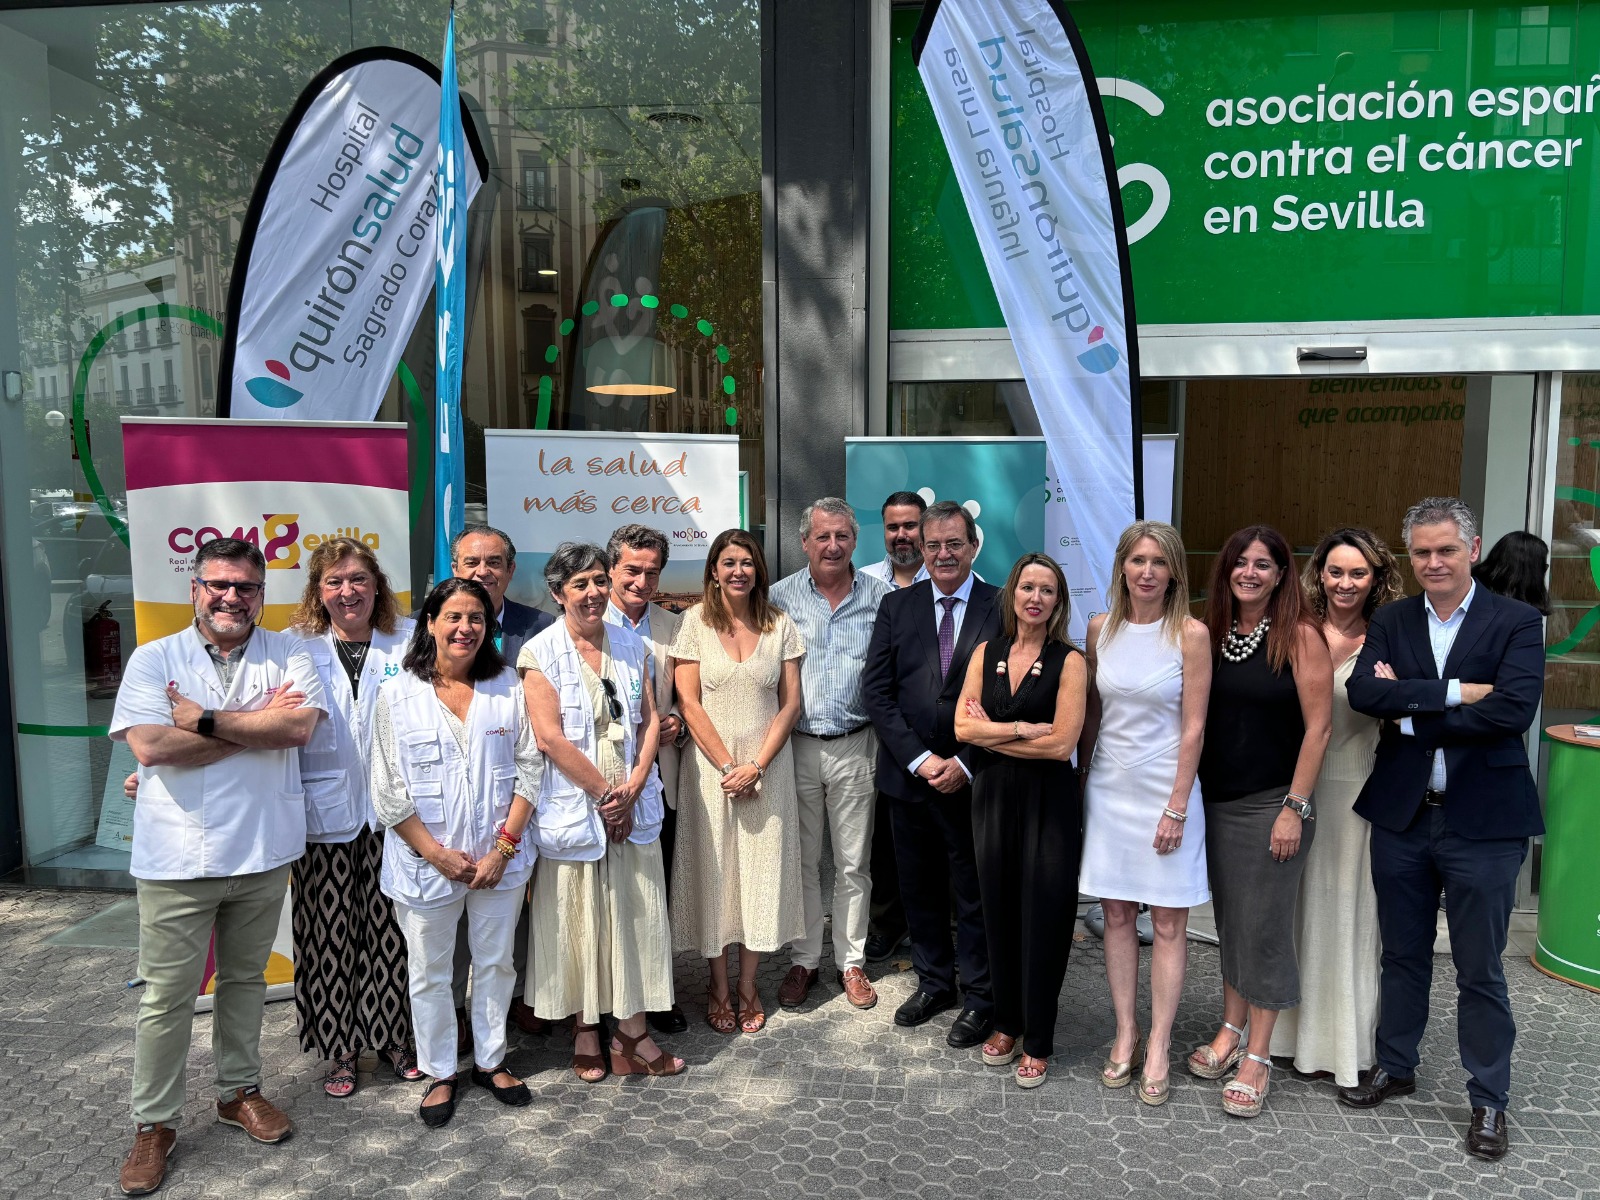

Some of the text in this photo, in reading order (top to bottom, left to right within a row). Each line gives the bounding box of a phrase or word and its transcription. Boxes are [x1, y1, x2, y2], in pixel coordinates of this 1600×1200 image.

[1205, 79, 1454, 128] asociación
[310, 101, 380, 213] Hospital
[1203, 131, 1582, 180] contra el cáncer
[1203, 190, 1425, 235] en Sevilla
[289, 122, 425, 372] quirónsalud
[343, 169, 438, 368] Sagrado Coraz
[1298, 406, 1339, 429] que
[538, 448, 688, 478] la salud
[523, 489, 703, 514] más cerca
[169, 557, 188, 565] Real
[174, 565, 185, 573] de
